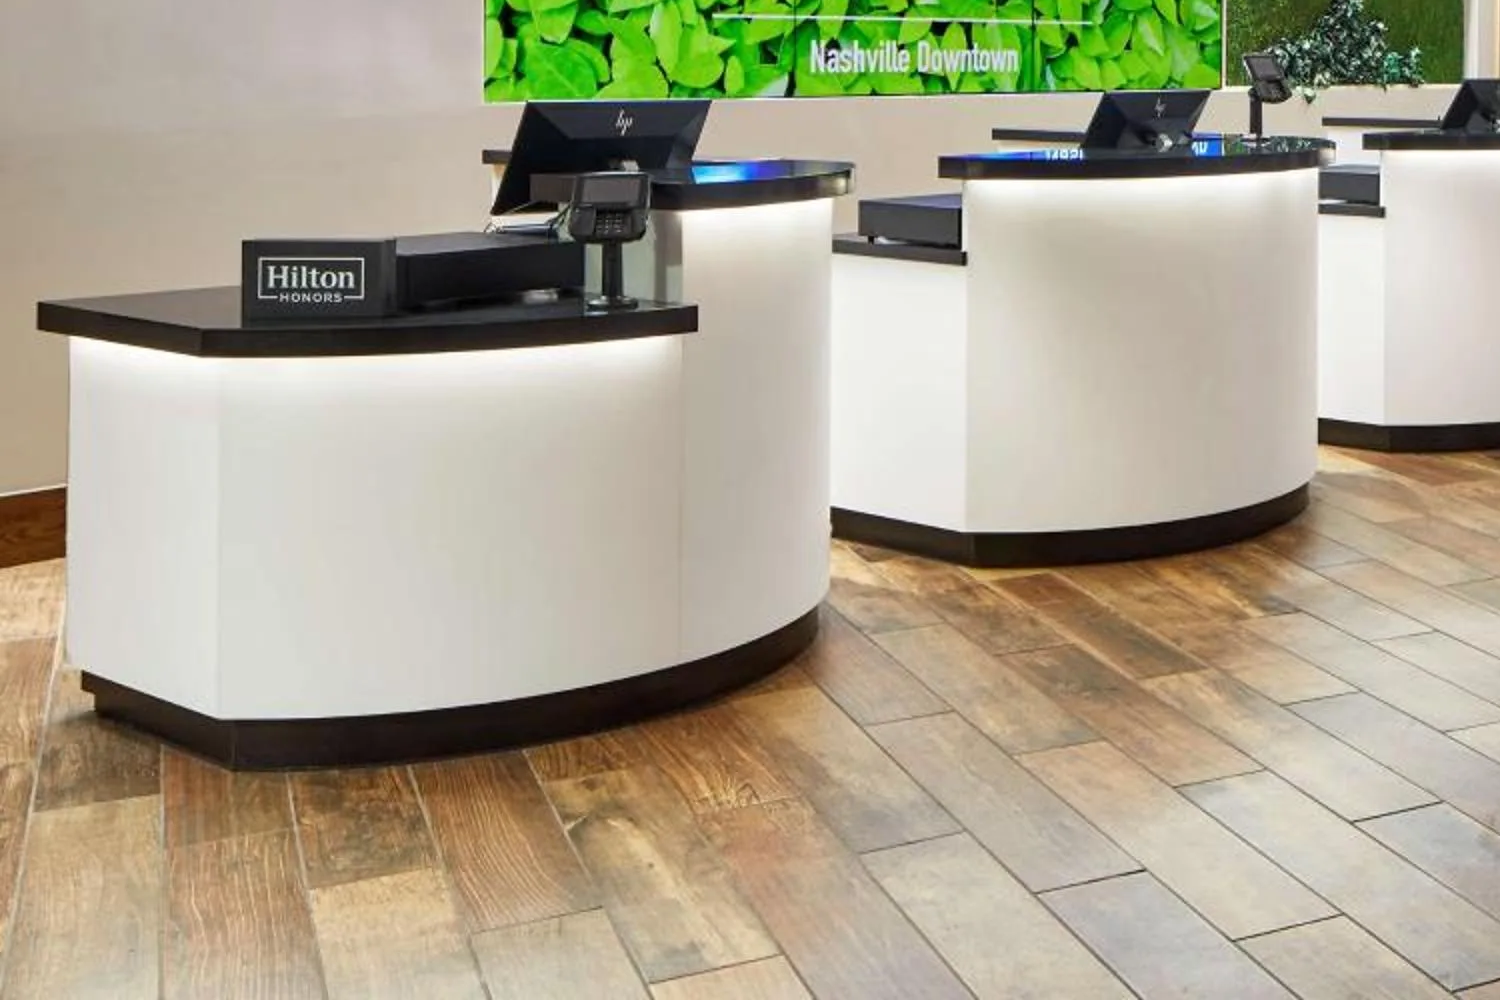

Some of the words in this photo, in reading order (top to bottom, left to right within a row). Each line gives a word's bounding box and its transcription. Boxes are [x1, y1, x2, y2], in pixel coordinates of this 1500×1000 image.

[810, 39, 910, 73] Nashville
[917, 40, 1019, 73] Downtown
[266, 265, 355, 289] Hilton
[279, 292, 343, 303] HONORS
